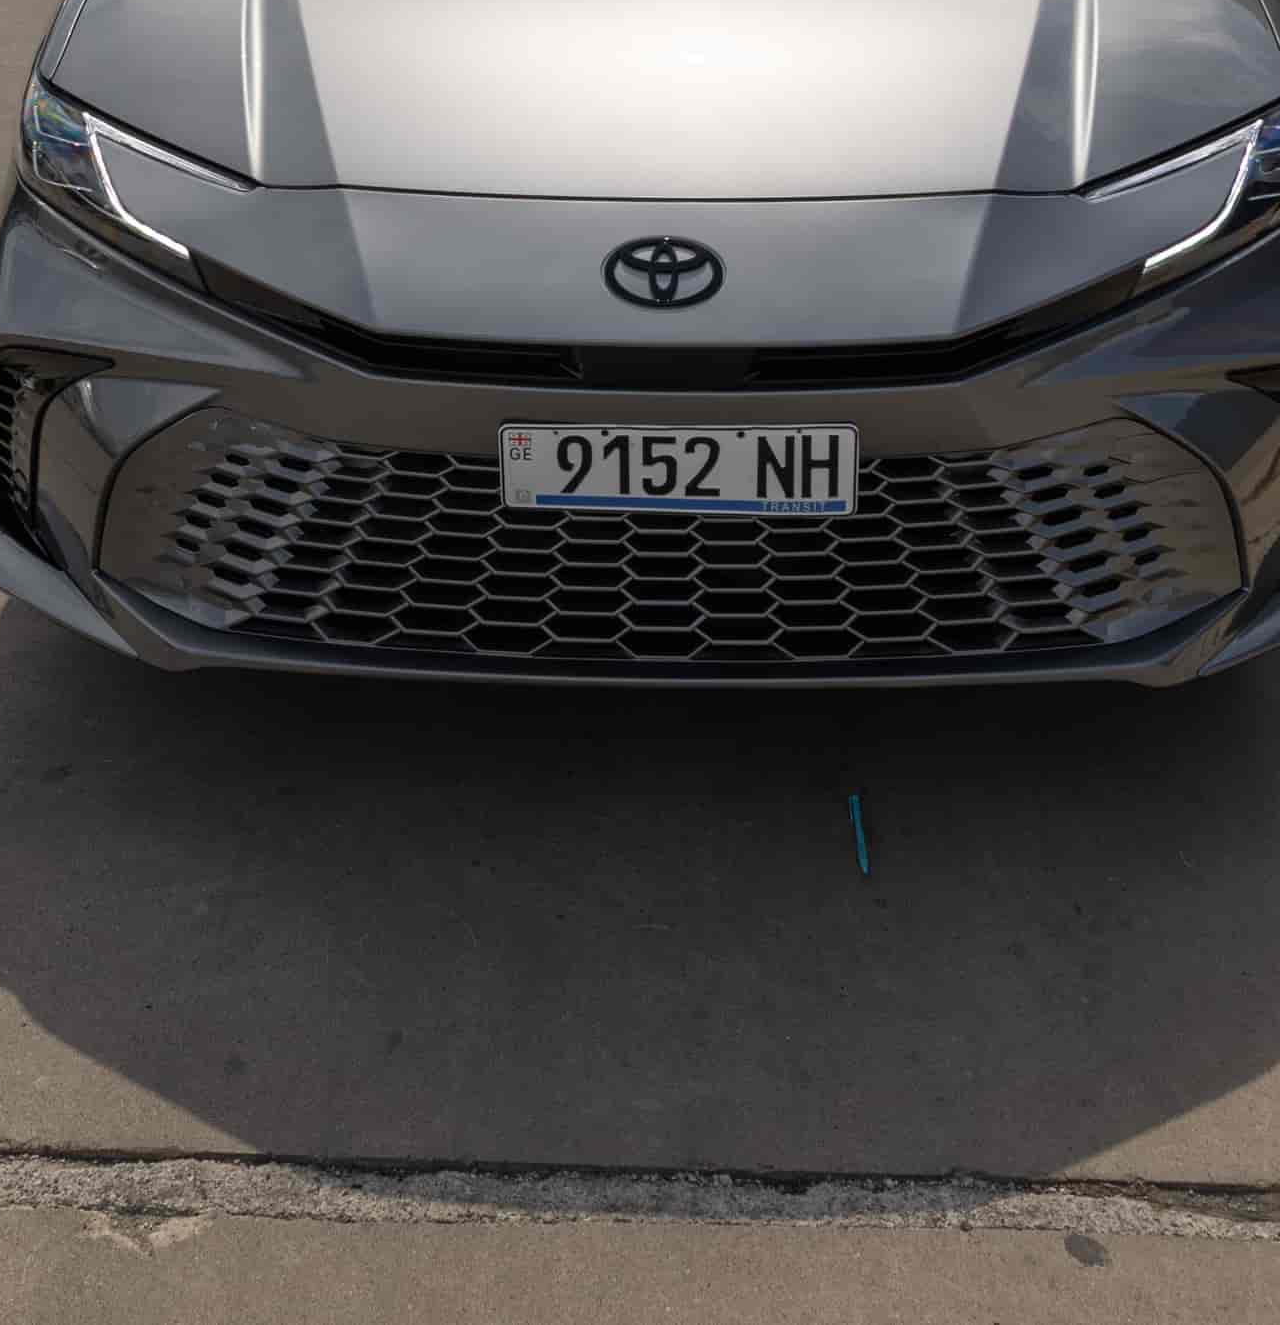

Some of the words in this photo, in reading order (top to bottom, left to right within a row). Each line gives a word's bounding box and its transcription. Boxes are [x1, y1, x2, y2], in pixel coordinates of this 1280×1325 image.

[509, 447, 533, 461] GE
[556, 434, 721, 496] 9152
[756, 434, 839, 498] NH
[762, 501, 826, 512] TRANSIT
